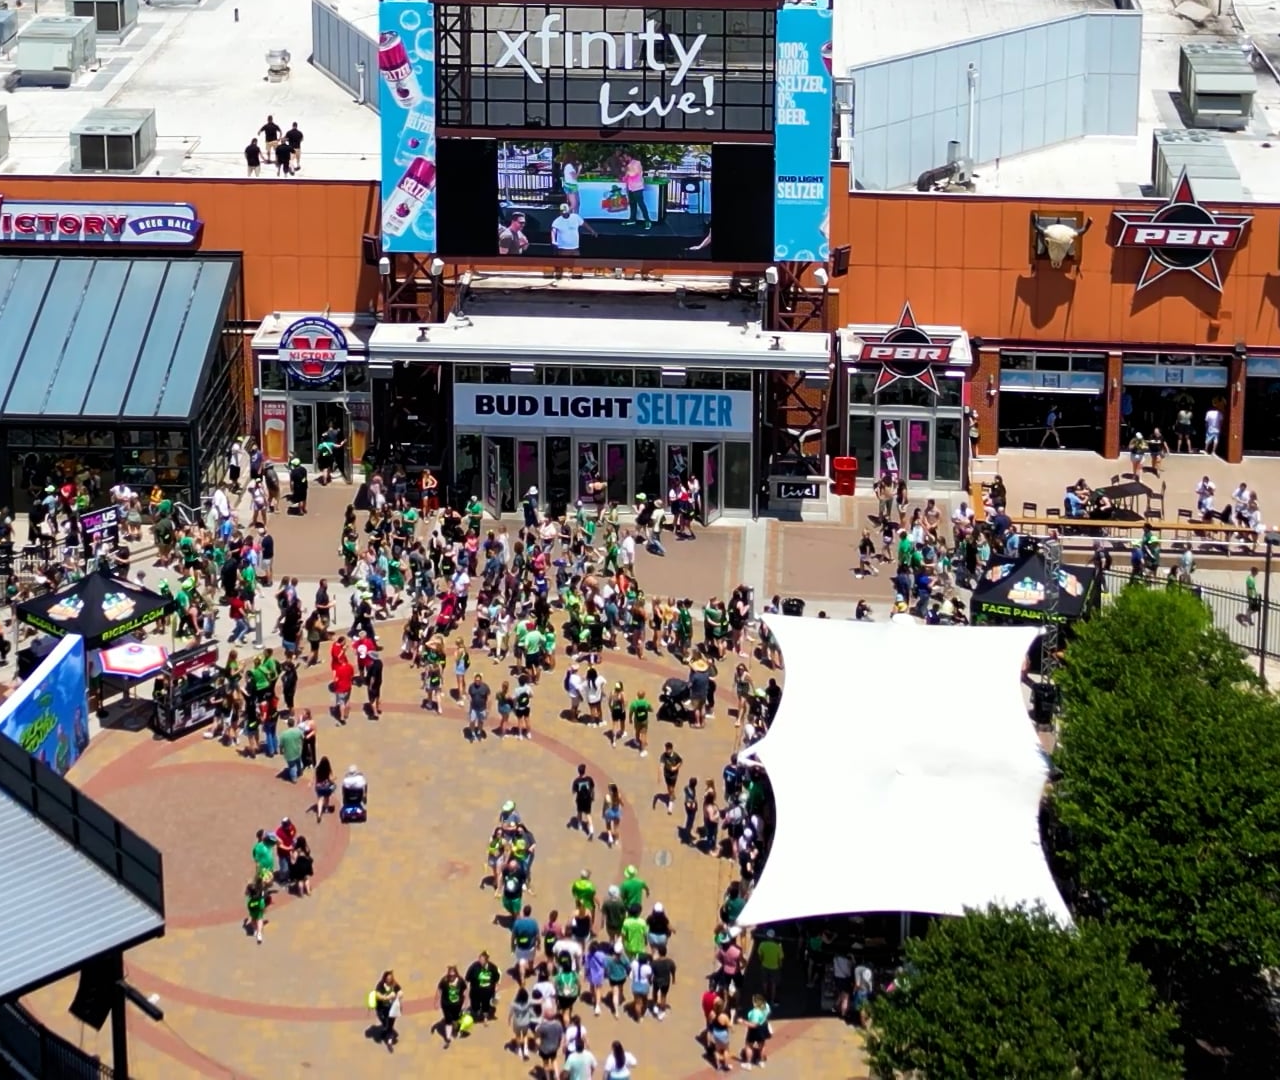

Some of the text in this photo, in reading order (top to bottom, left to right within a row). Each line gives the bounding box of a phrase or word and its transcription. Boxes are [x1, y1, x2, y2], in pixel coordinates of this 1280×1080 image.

[494, 14, 708, 87] xfinity
[778, 42, 808, 59] 100%
[777, 59, 808, 75] HARD
[777, 75, 827, 94] SELTZER,
[599, 76, 715, 126] Live!
[777, 92, 796, 109] 0%
[777, 108, 810, 125] BEER.
[777, 182, 824, 199] SELTZER
[138, 218, 163, 231] BEER
[167, 219, 192, 231] HALL
[1134, 228, 1230, 246] PBR
[289, 352, 336, 361] VICTORY
[870, 347, 942, 360] PBR
[475, 392, 733, 427] BUD LIGHT SELTZER
[781, 484, 816, 498] Live!
[102, 510, 116, 521] US
[982, 603, 1011, 616] FACE
[102, 608, 164, 641] BIGDILL.COM
